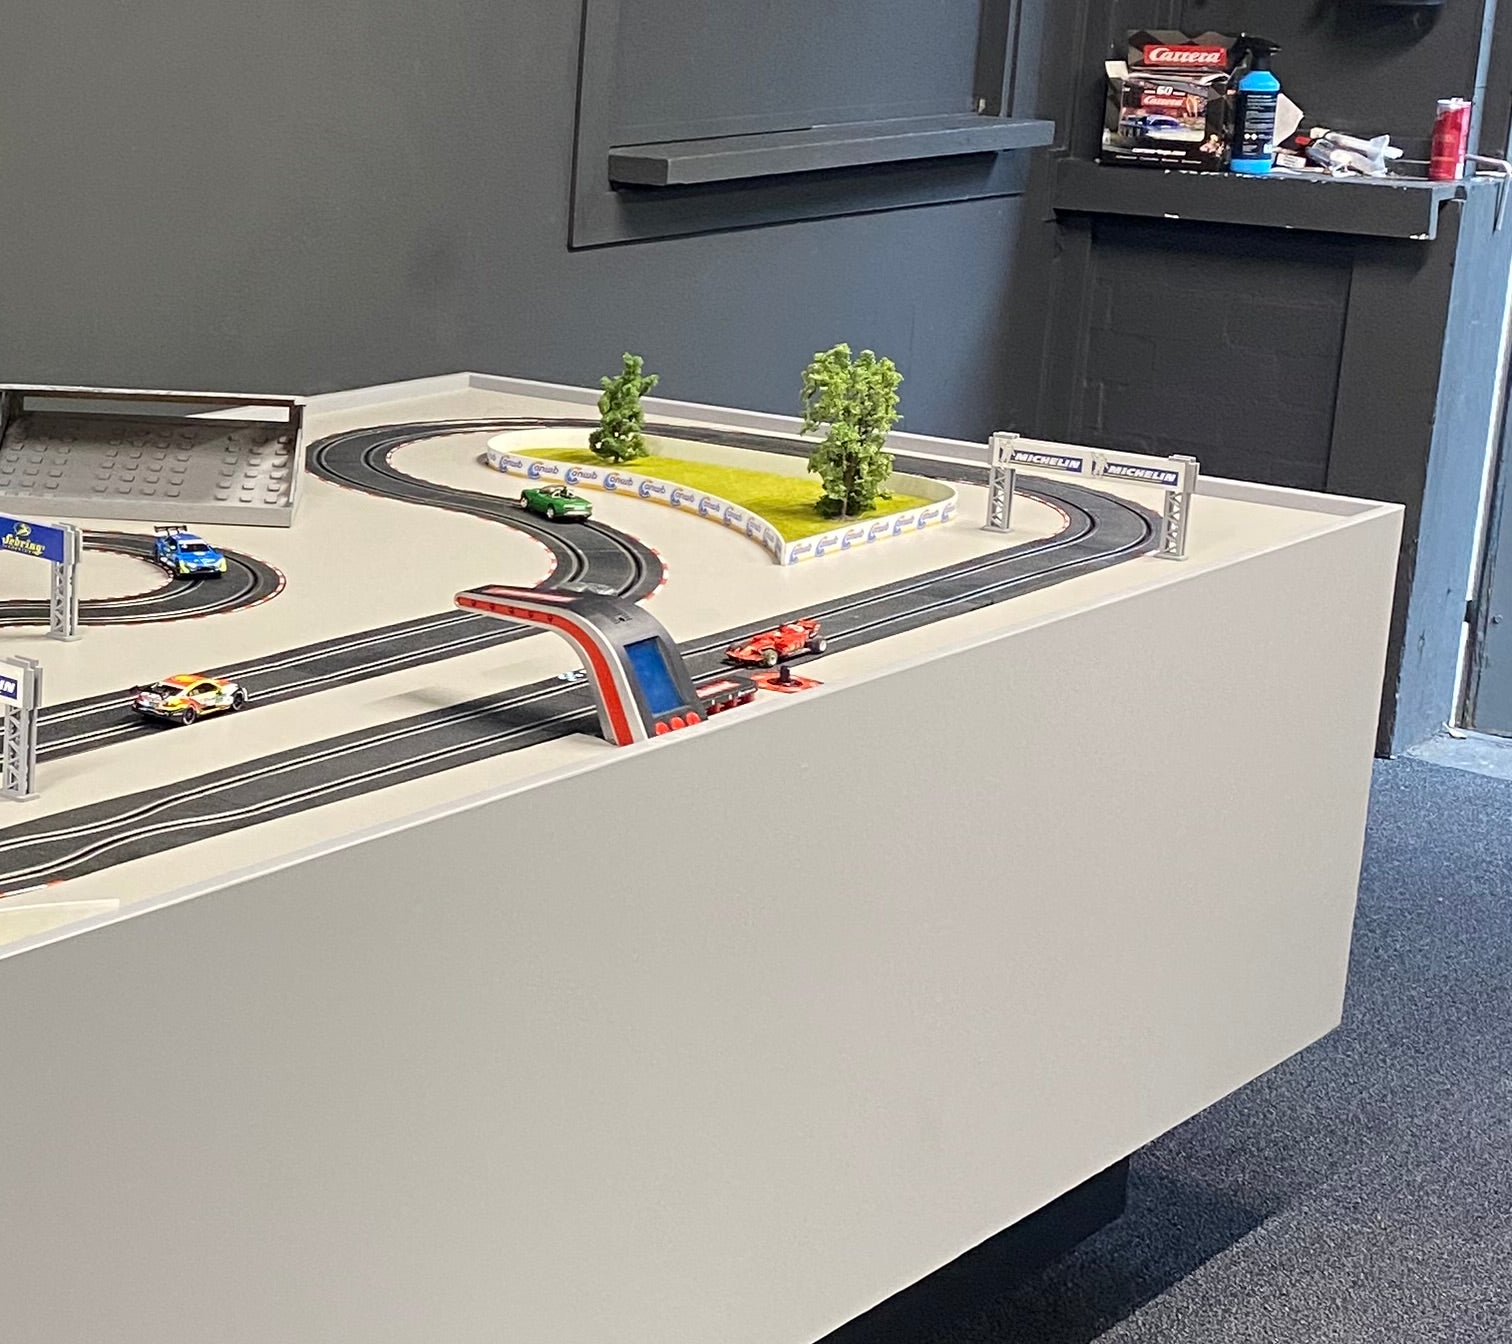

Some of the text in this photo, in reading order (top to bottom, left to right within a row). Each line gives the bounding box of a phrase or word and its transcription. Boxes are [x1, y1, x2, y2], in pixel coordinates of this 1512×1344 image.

[1148, 47, 1221, 64] Carrera
[1015, 452, 1081, 469] MICHELIN
[1108, 465, 1177, 482] MICHELIN
[2, 533, 45, 556] Sebring
